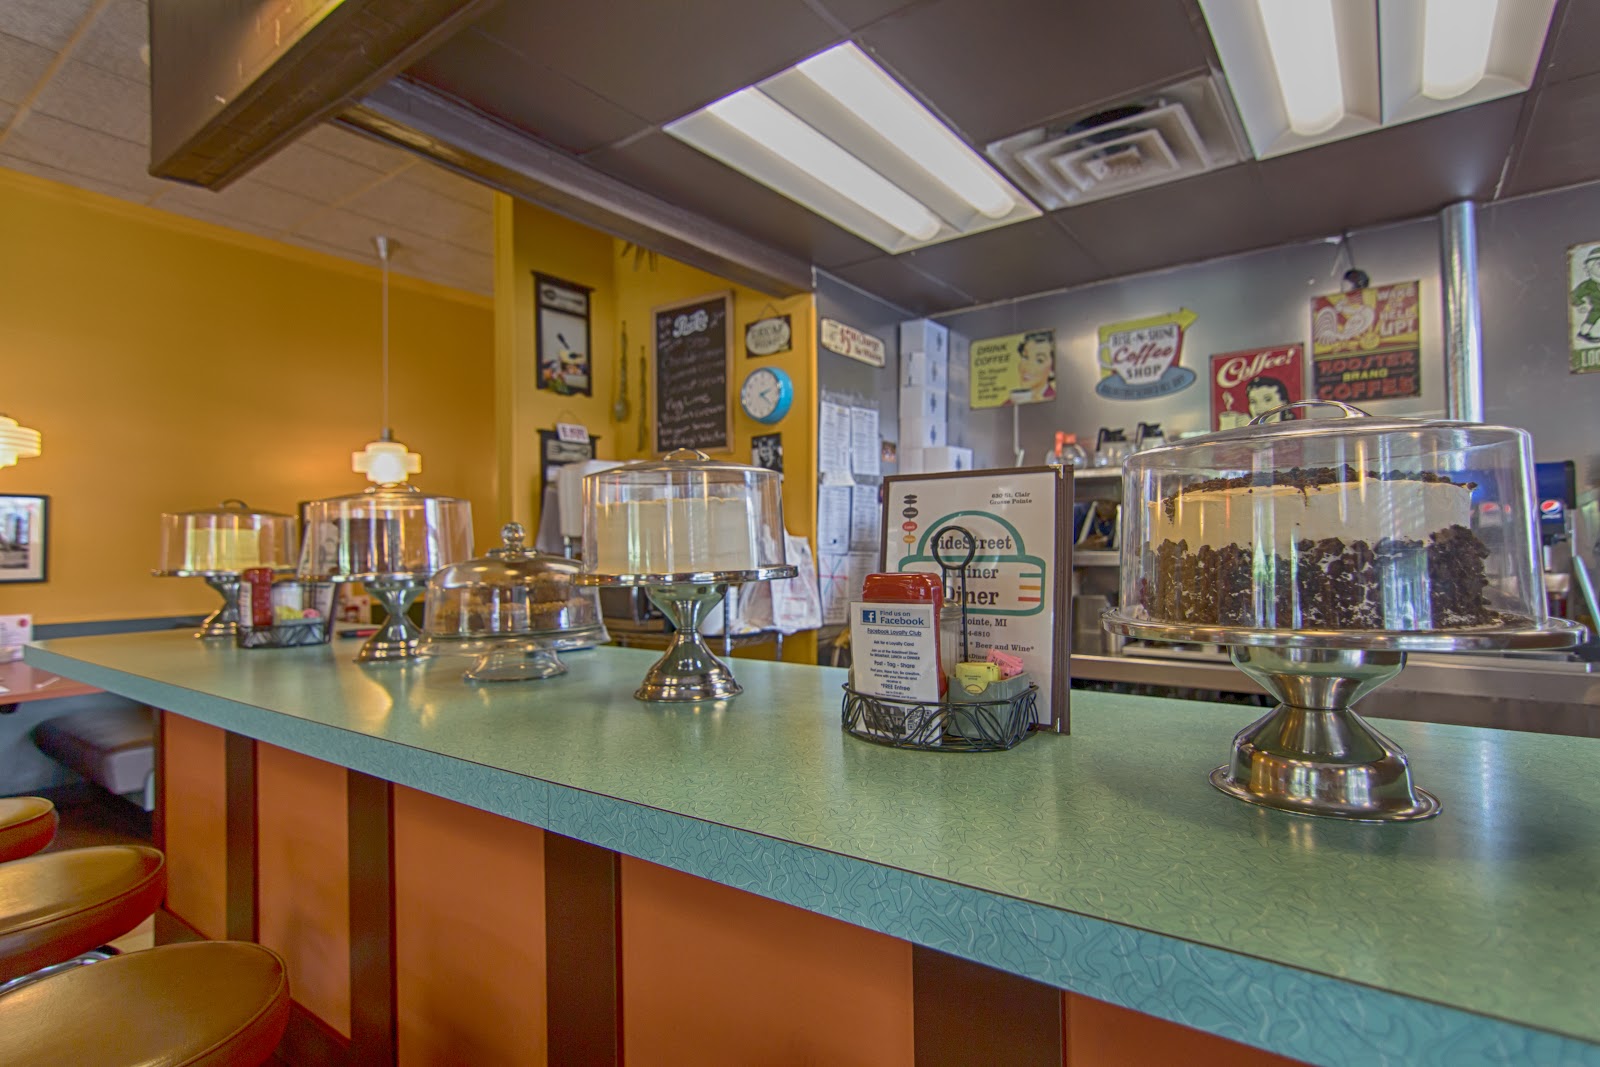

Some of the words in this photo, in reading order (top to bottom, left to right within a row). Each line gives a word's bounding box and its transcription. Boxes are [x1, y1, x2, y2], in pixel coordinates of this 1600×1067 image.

[1380, 319, 1414, 336] UP!
[974, 353, 1011, 368] COFFEE
[1113, 341, 1173, 365] Coffee
[1216, 347, 1296, 389] Coffee!
[1318, 351, 1415, 375] ROOSTER
[1126, 364, 1162, 380] SHOP
[1342, 368, 1389, 383] BRAND
[1318, 375, 1415, 401] COFFEE
[880, 617, 925, 626] Facebook
[962, 617, 992, 627] ointe,
[995, 618, 1008, 627] MI
